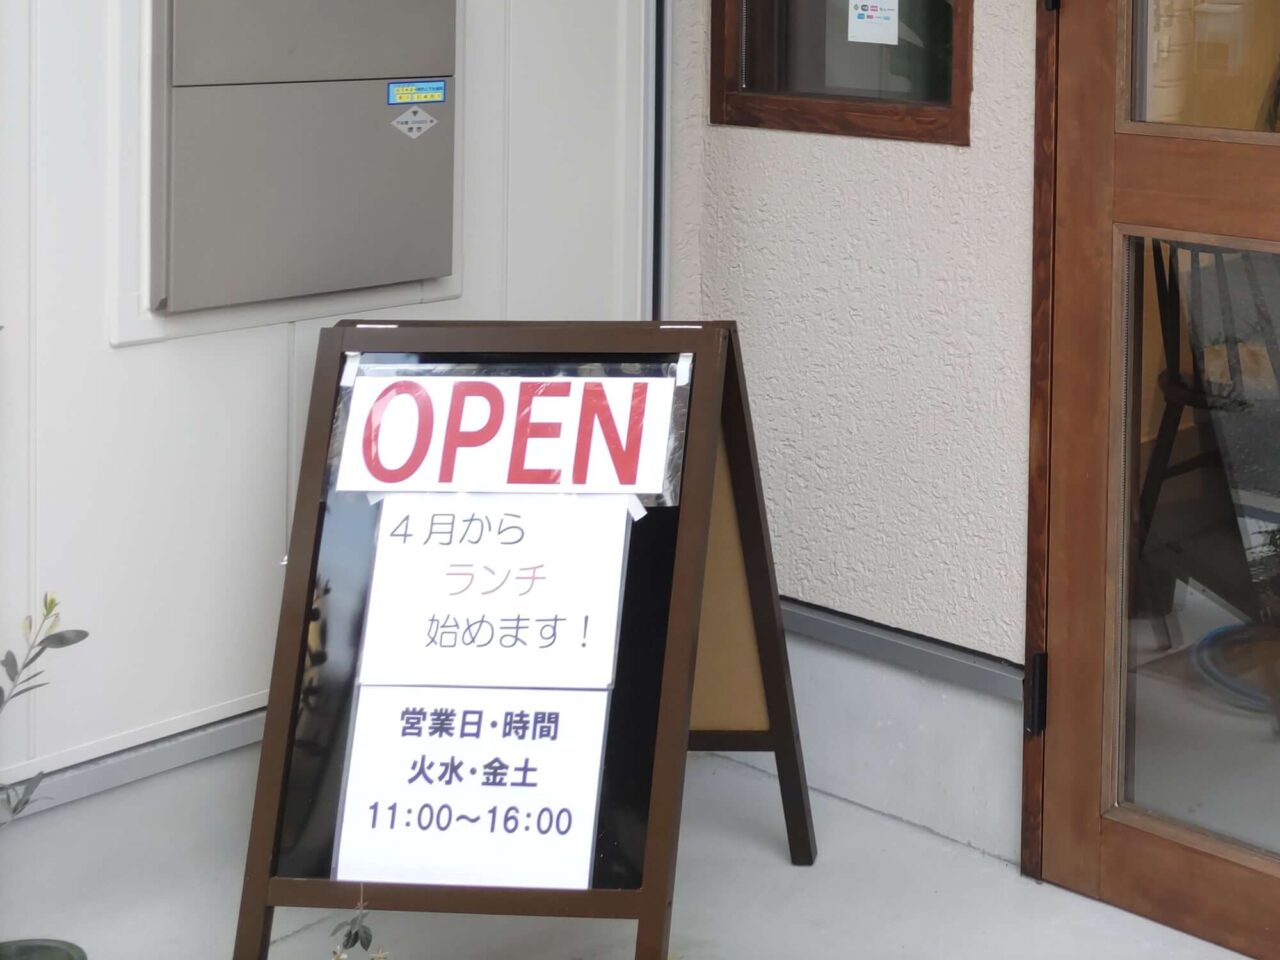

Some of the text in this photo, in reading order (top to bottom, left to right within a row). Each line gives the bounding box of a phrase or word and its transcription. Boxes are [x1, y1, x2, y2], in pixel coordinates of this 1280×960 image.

[362, 381, 648, 485] OPEN
[446, 564, 547, 597] ランチ
[425, 614, 590, 649] 始めます！
[400, 707, 560, 741] 営業日・時間
[407, 754, 538, 788] 火水・金土
